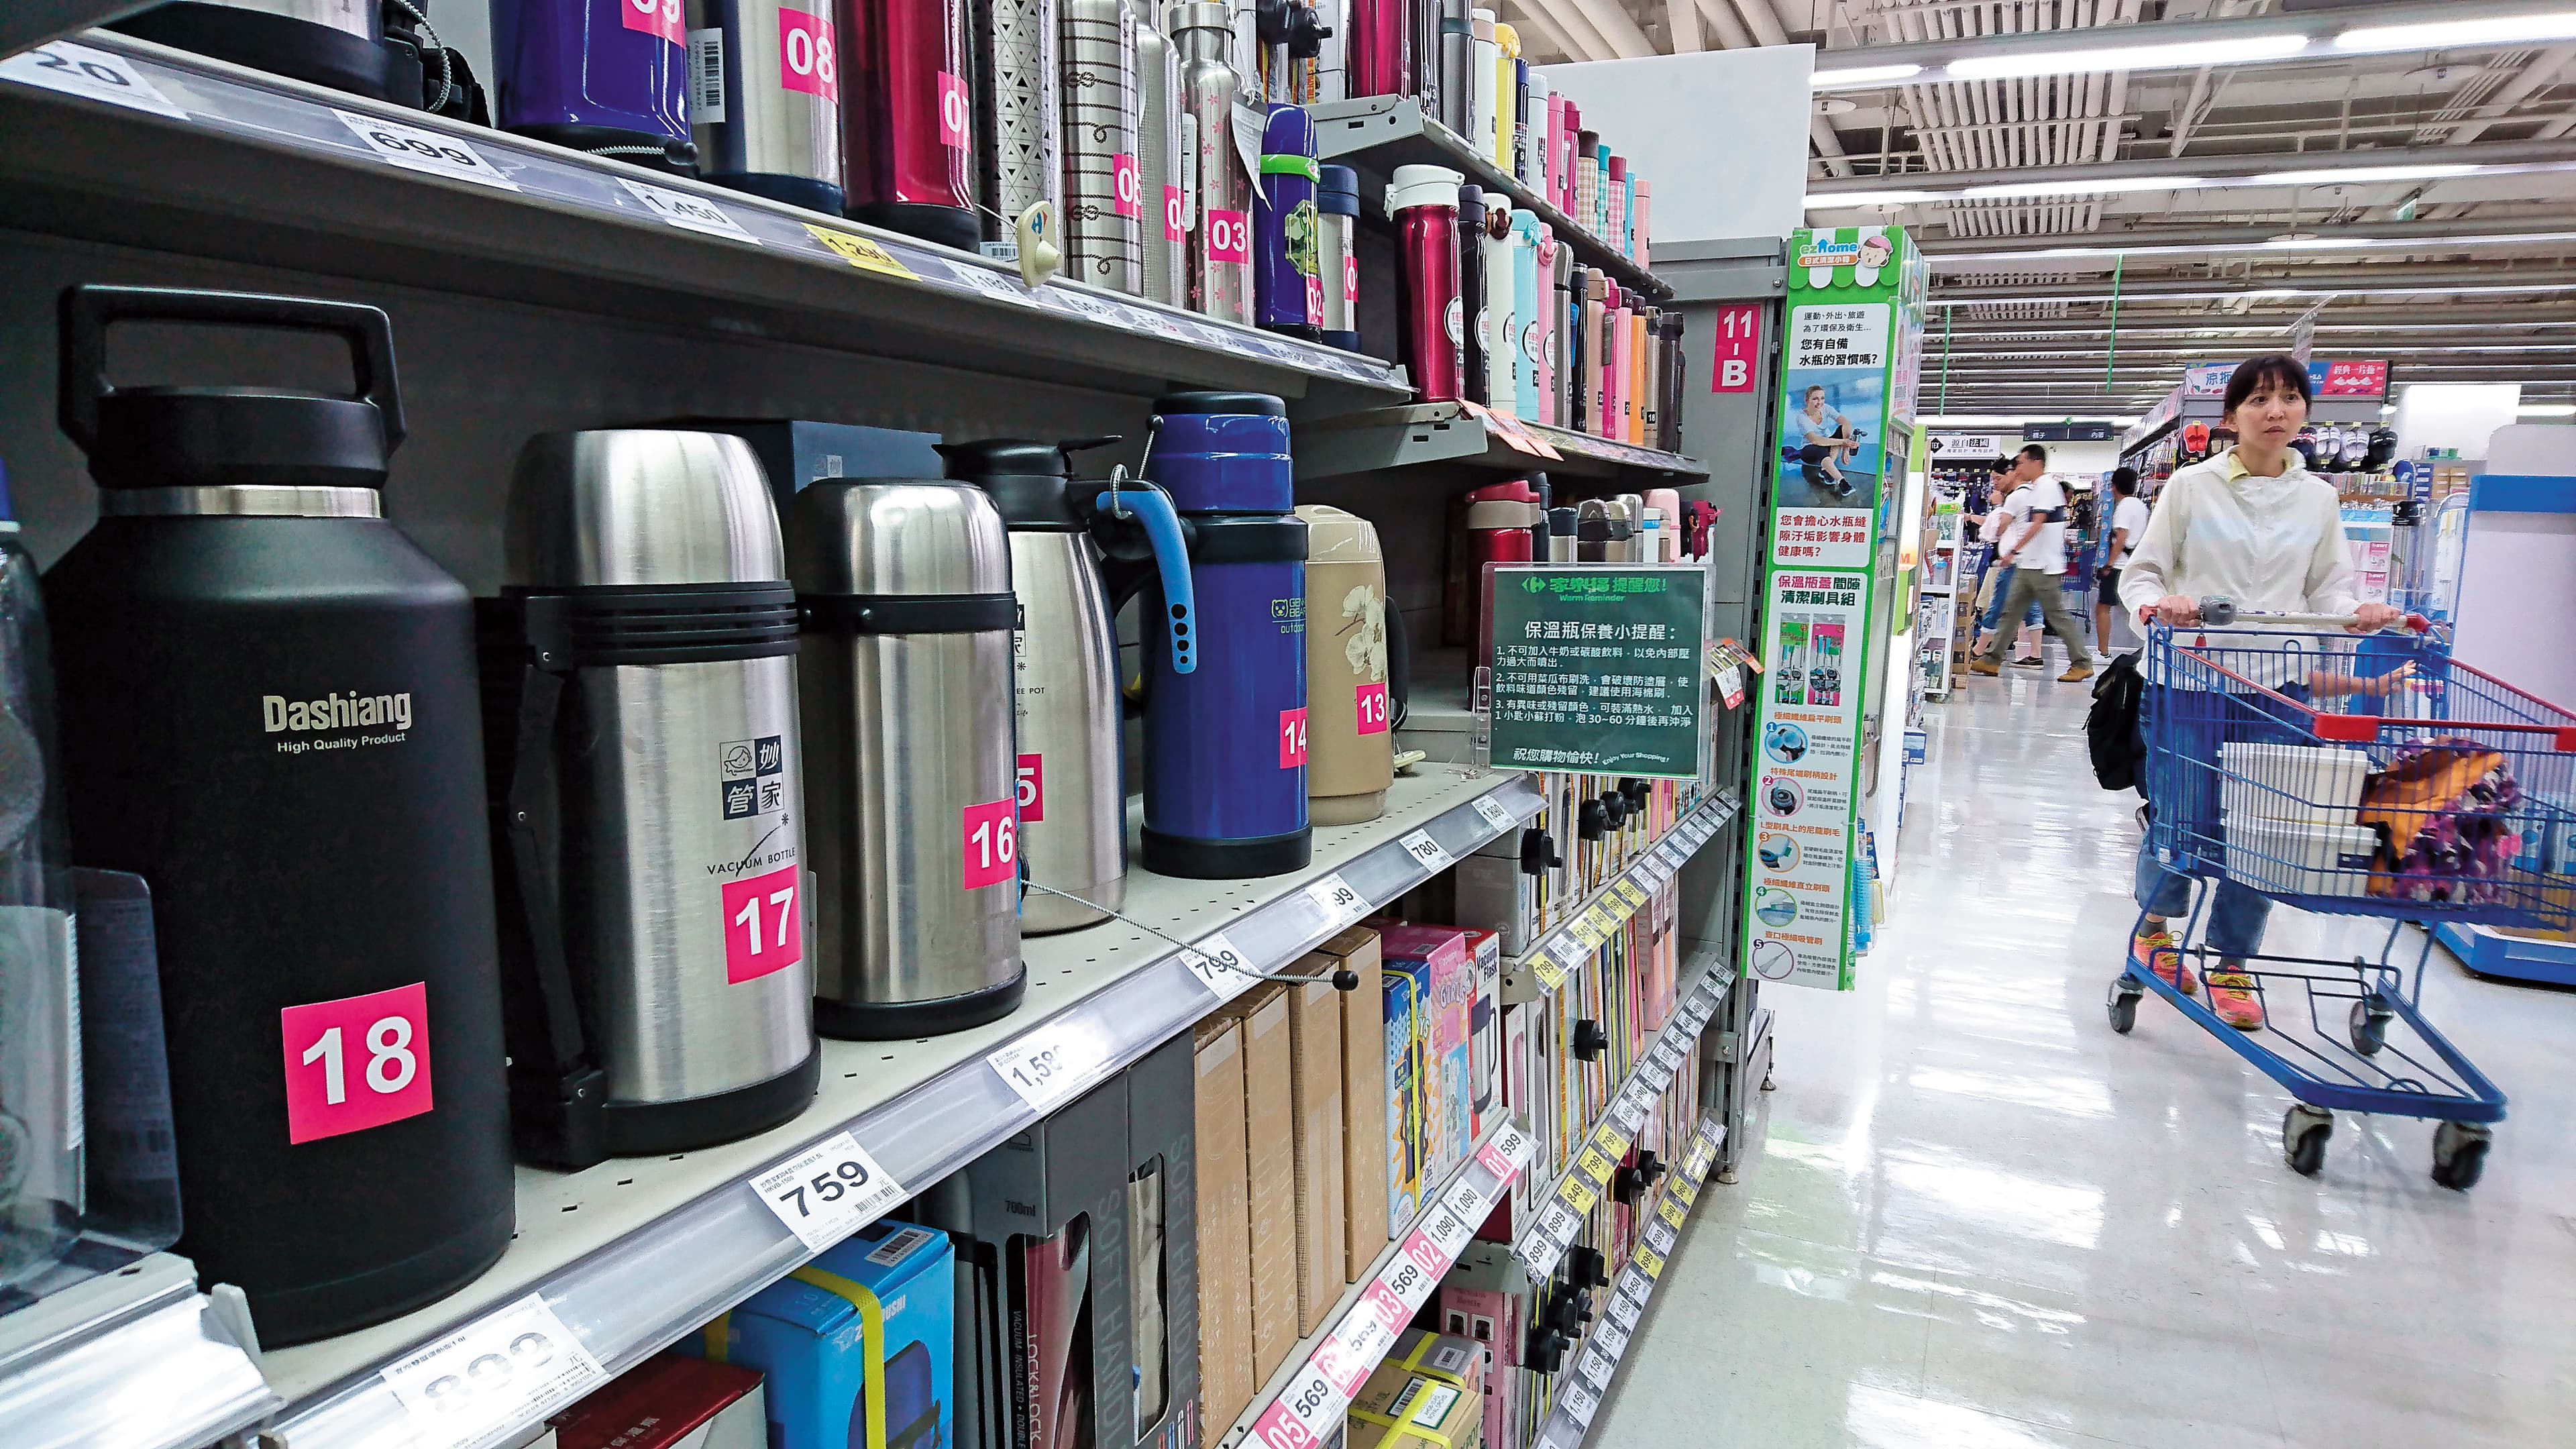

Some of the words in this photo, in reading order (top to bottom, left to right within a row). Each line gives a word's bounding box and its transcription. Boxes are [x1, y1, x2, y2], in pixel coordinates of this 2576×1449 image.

[787, 28, 832, 84] 08
[369, 131, 477, 166] 699
[645, 195, 727, 224] 1,450
[1213, 220, 1246, 252] 03
[1347, 266, 1358, 292] 0
[1308, 286, 1322, 318] 02
[1723, 309, 1753, 339] 11
[1804, 311, 1865, 320] 運動、外出、旅遊
[1801, 337, 1848, 350] 您有自備
[1799, 354, 1878, 366] 水瓶的習慣嗎?
[1722, 359, 1748, 387] B
[1648, 413, 1656, 422] 18
[1780, 515, 1867, 527] 您會擔心水瓶縫
[1778, 545, 1821, 558] 健康嗎?
[1780, 590, 1856, 606] 清潔刷具組
[263, 690, 412, 732] Dashiang
[1361, 693, 1385, 723] 13
[1671, 704, 1693, 716] 加入
[277, 741, 310, 754] High
[313, 737, 358, 750] Quality
[362, 732, 406, 746] Product
[1285, 718, 1307, 755] 14
[759, 741, 780, 770] 妙
[1602, 756, 1619, 765] Enjoy
[727, 780, 782, 816] 管家
[1018, 767, 1036, 807] 5
[1483, 804, 1504, 821] 1,890
[971, 816, 1014, 869] 16
[1412, 841, 1438, 859] 780
[707, 857, 763, 875] VACUUM
[768, 847, 796, 864] BOTTLE
[1334, 888, 1354, 907] 99
[1623, 885, 1636, 898] 699
[1609, 898, 1622, 911] 699
[736, 885, 794, 957] 17
[1592, 911, 1607, 926] 649
[1577, 925, 1592, 941] 549
[1195, 950, 1238, 979] 799
[1477, 947, 1497, 971] Vacuum
[1536, 960, 1554, 977] 799
[1483, 962, 1498, 983] Flask
[1693, 1002, 1704, 1015] 499
[1683, 1017, 1693, 1030] 449
[1673, 1032, 1683, 1046] 449
[303, 1016, 417, 1106] 18
[1013, 1044, 1063, 1085] 1,58
[1635, 1086, 1648, 1102] 990
[1621, 1106, 1635, 1124] 1,050
[1603, 1132, 1618, 1150] 799
[1486, 1150, 1510, 1177] 01
[1501, 1134, 1521, 1157] 599
[1587, 1155, 1603, 1175] 799
[779, 1161, 869, 1218] 759
[1171, 1134, 1190, 1230] SOFT
[1566, 1183, 1584, 1203] 849
[1676, 1183, 1688, 1197] 960
[1454, 1188, 1478, 1215] 1,090
[1548, 1212, 1566, 1234] 899
[1664, 1205, 1676, 1221] 990
[1097, 1189, 1123, 1292] SOFT
[1412, 1240, 1442, 1272] 02
[1431, 1215, 1456, 1244] 1,090
[1653, 1229, 1664, 1246] 599
[1529, 1240, 1548, 1264] 899
[1640, 1251, 1654, 1269] 899
[1375, 1289, 1402, 1324] 03
[1392, 1264, 1419, 1295] 569
[1627, 1277, 1642, 1296] 950
[1172, 1241, 1194, 1393] HANDLE
[1616, 1300, 1630, 1321] 1,150
[1601, 1328, 1617, 1349] 1,150
[1015, 1352, 1024, 1403] INSULATED
[1587, 1356, 1603, 1380] 1,150
[1268, 1411, 1306, 1449] 05
[1295, 1379, 1329, 1418] 569
[1570, 1391, 1586, 1415] 1,150
